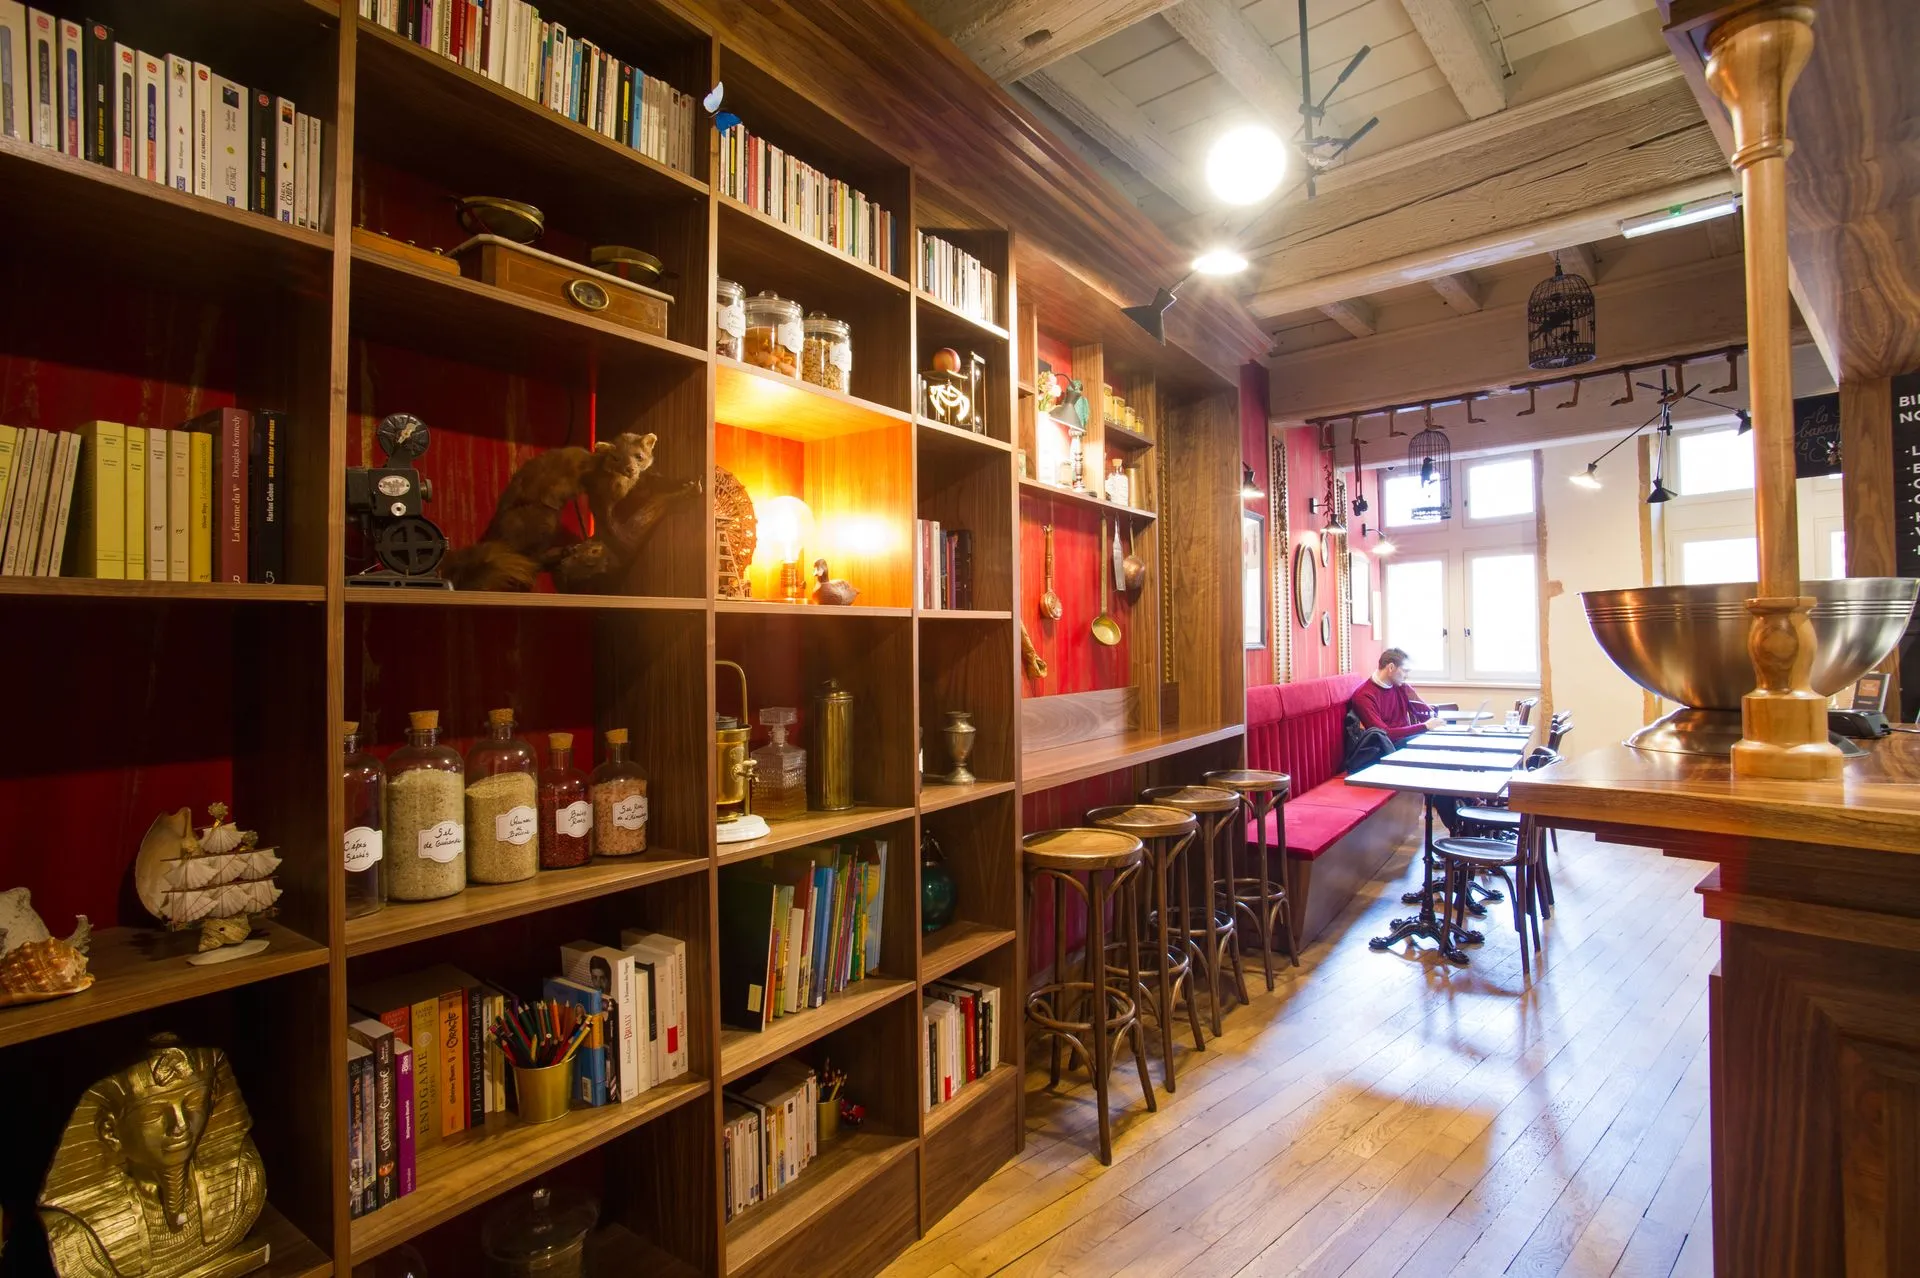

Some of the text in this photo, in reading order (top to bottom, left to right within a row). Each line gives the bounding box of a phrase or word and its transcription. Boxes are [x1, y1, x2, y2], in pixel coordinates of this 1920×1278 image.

[228, 166, 237, 192] GEORGE
[232, 415, 242, 478] Douglas Kennedy
[232, 494, 240, 504] du
[266, 483, 274, 521] Harlan Coben
[232, 504, 240, 531] femme
[232, 532, 240, 542] La
[434, 828, 453, 839] Sel
[623, 1014, 633, 1040] BRIALY
[417, 1050, 430, 1136] ENDGAME
